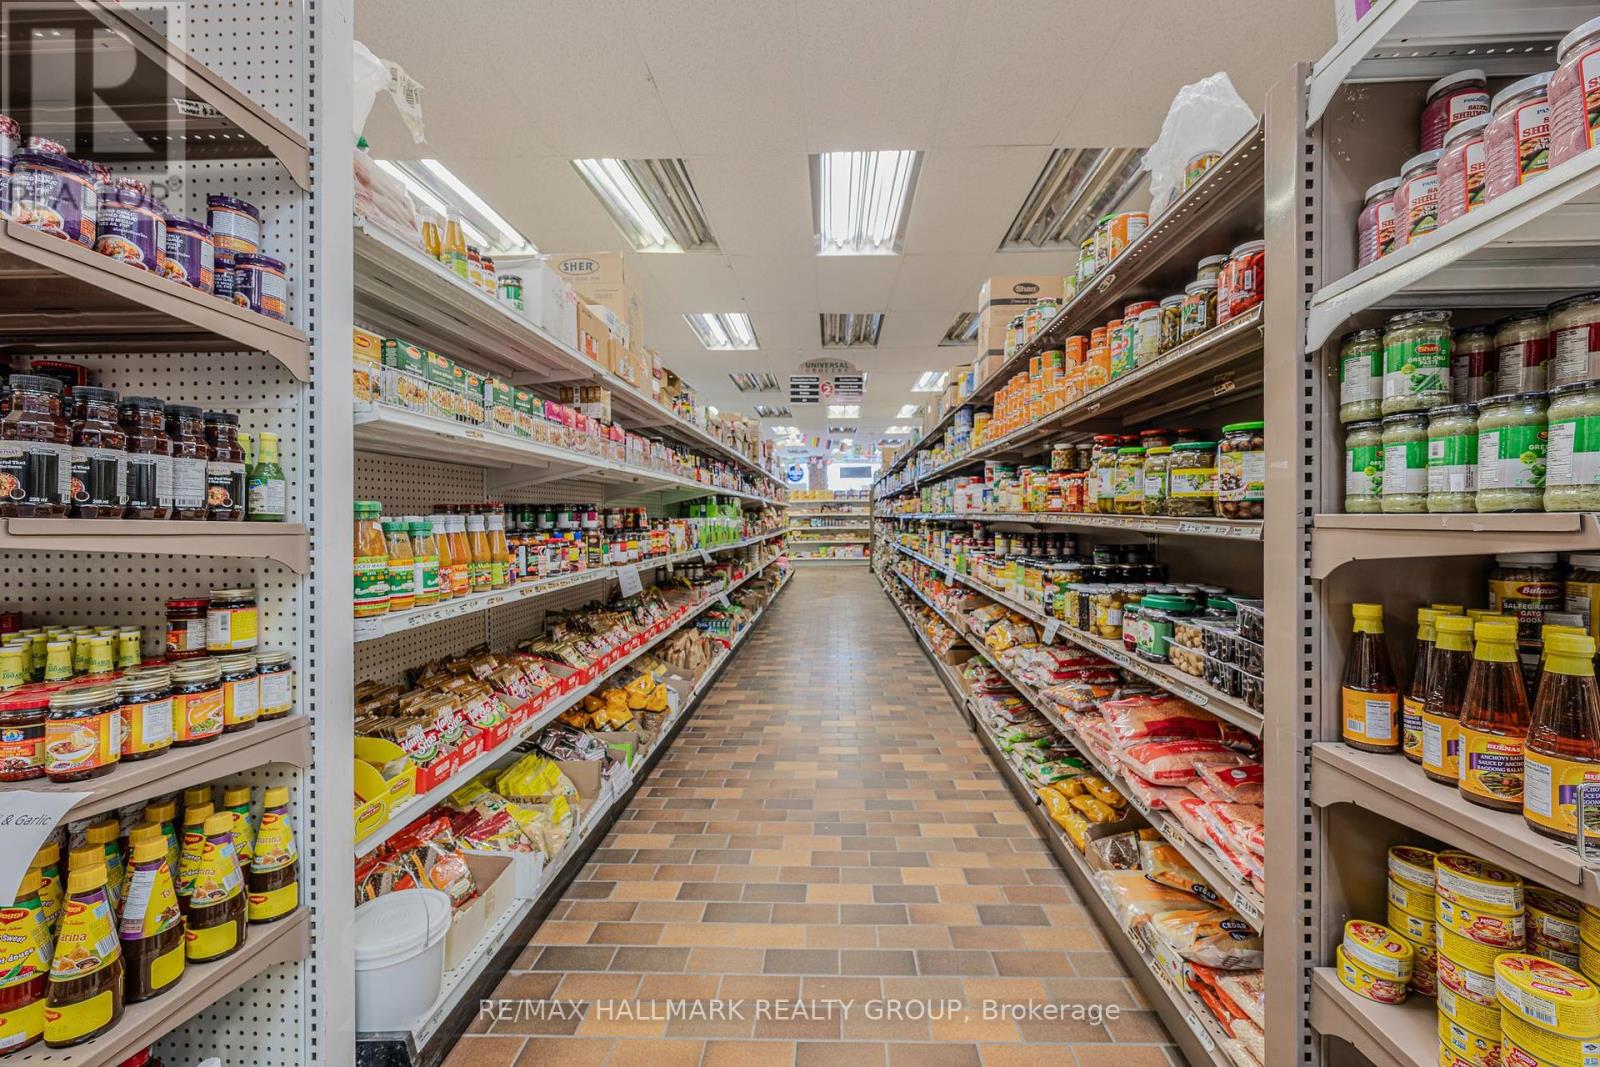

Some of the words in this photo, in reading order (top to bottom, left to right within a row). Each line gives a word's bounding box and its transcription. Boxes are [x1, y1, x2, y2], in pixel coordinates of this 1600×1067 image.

[563, 261, 594, 272] SHER
[1015, 285, 1037, 293] Shan
[805, 361, 849, 369] UNIVERSAL
[1, 814, 11, 826] &
[13, 813, 52, 827] Garlic
[1193, 885, 1217, 900] CEDAR
[1221, 921, 1248, 929] CEDAR
